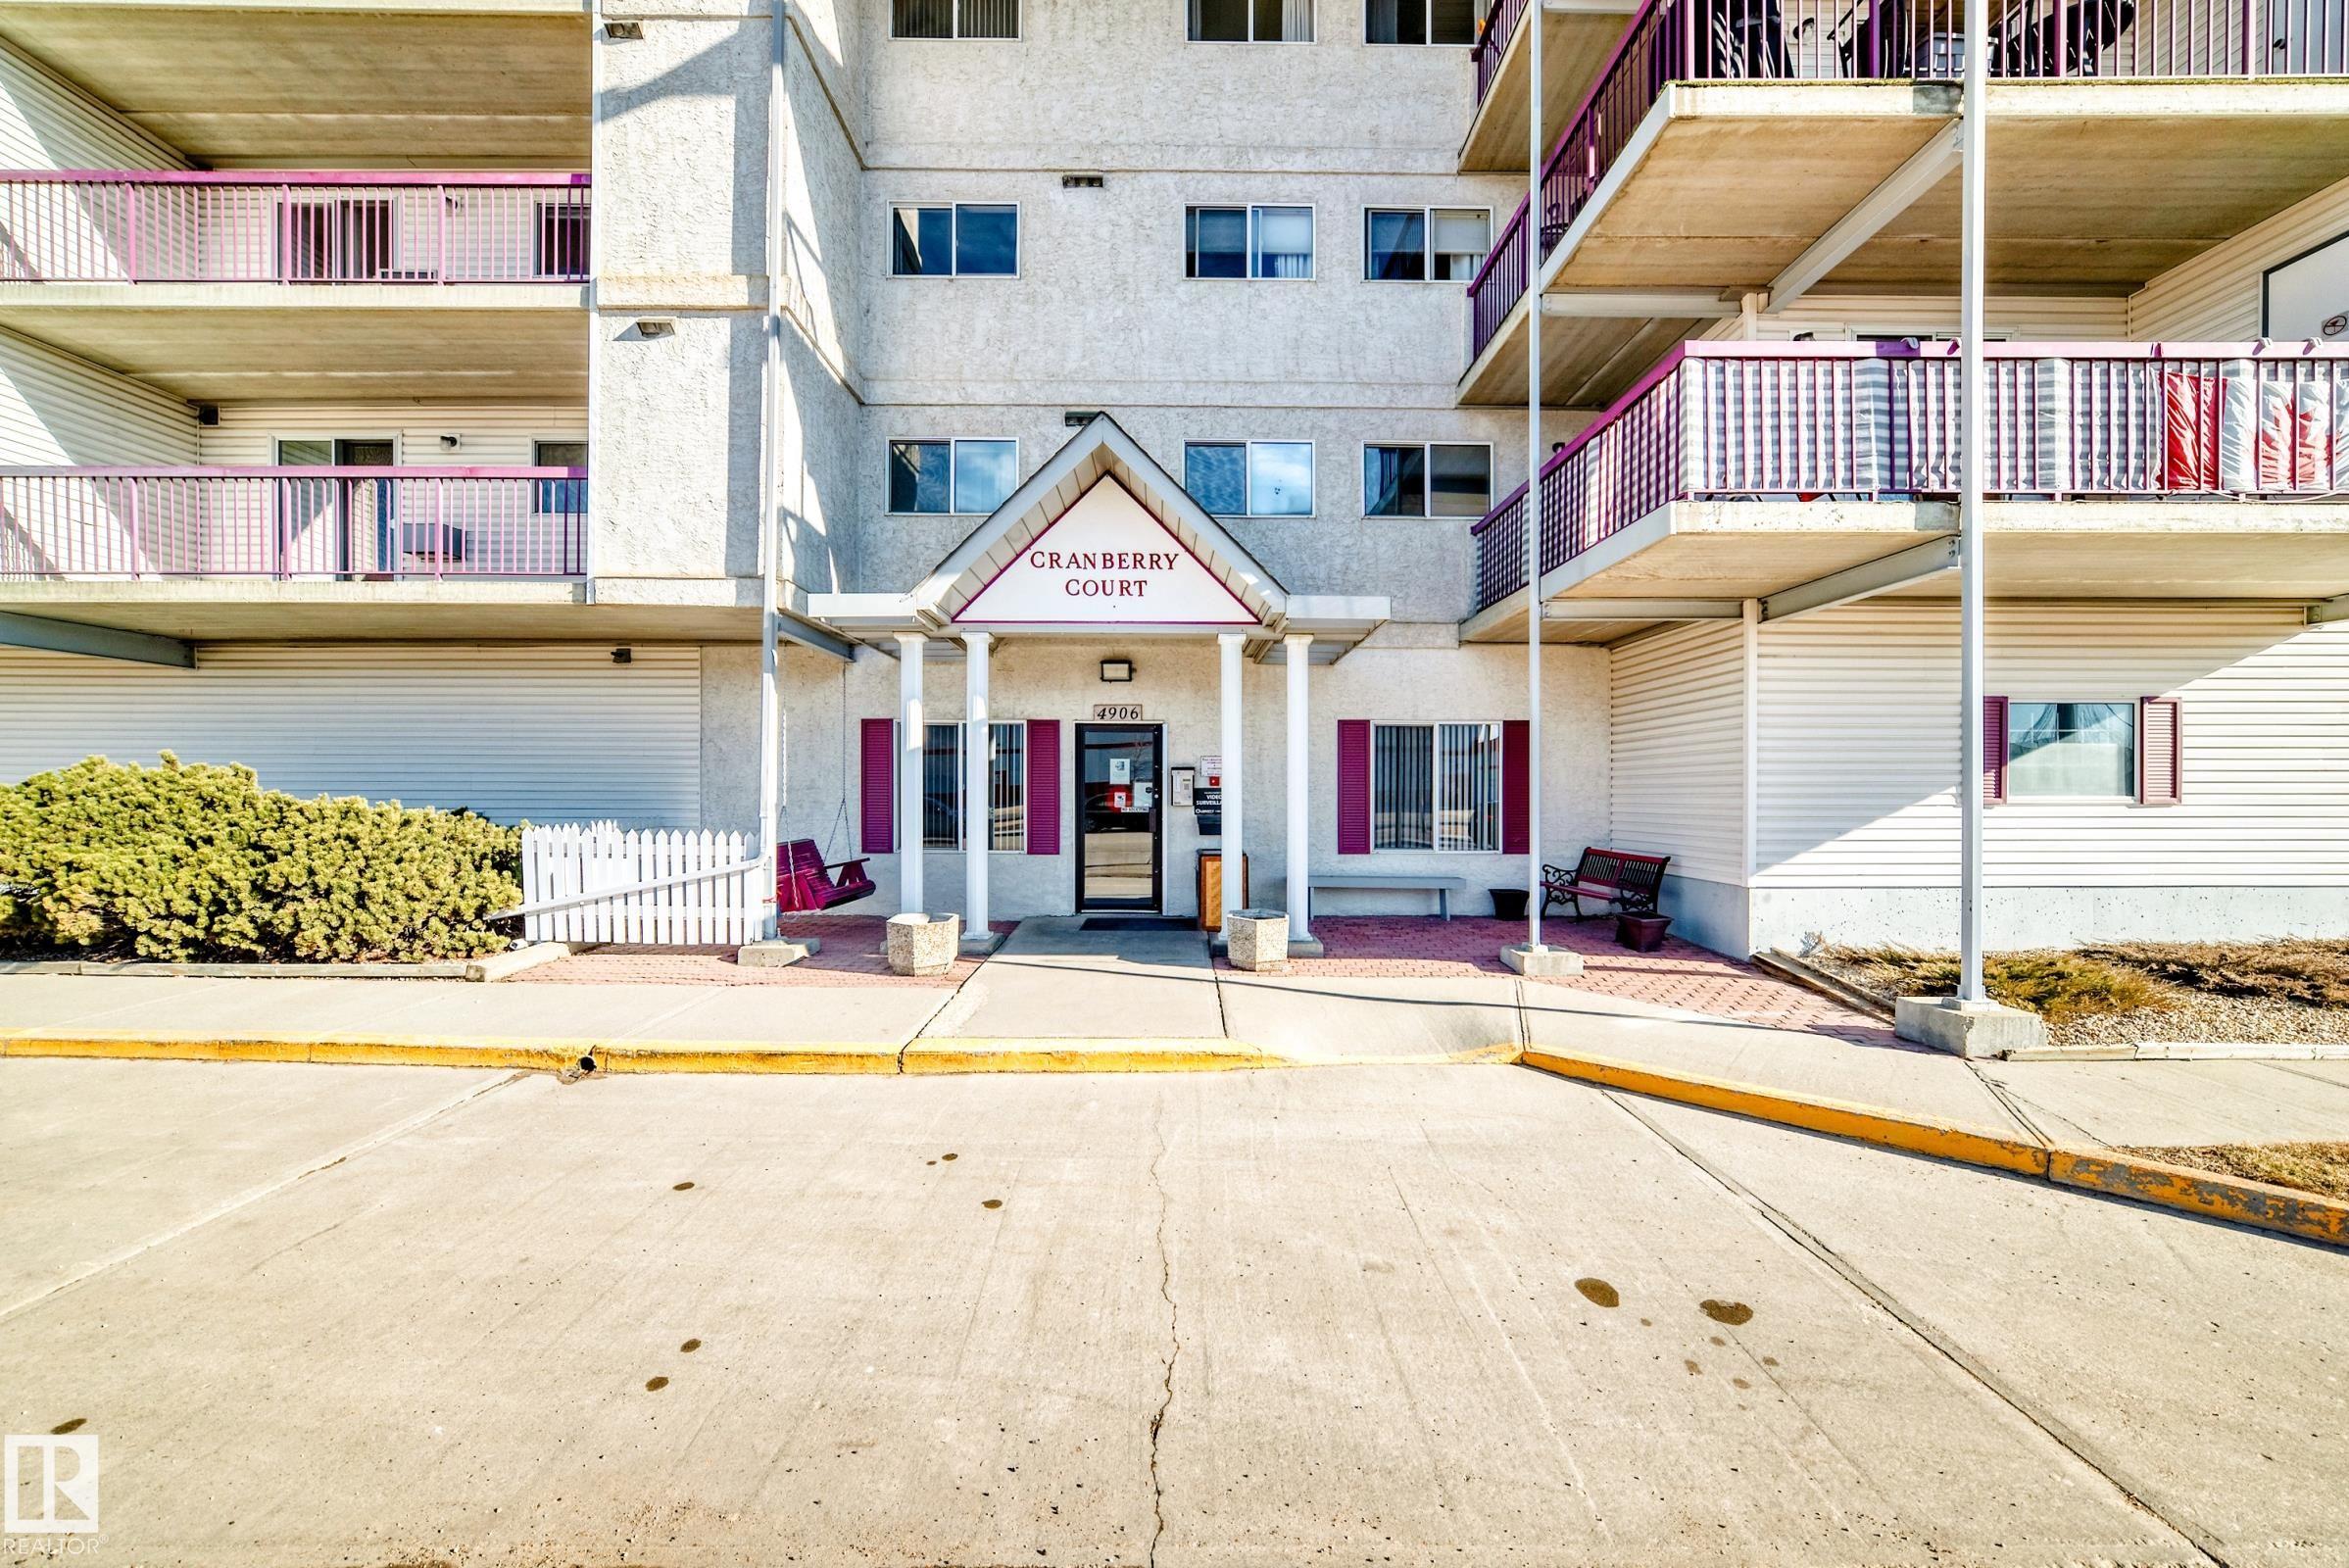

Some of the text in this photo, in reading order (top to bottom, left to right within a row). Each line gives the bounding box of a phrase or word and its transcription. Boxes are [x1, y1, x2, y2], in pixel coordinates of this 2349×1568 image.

[1030, 551, 1179, 569] CRANBERRY
[1065, 579, 1148, 597] COURT
[1097, 707, 1139, 719] 4906
